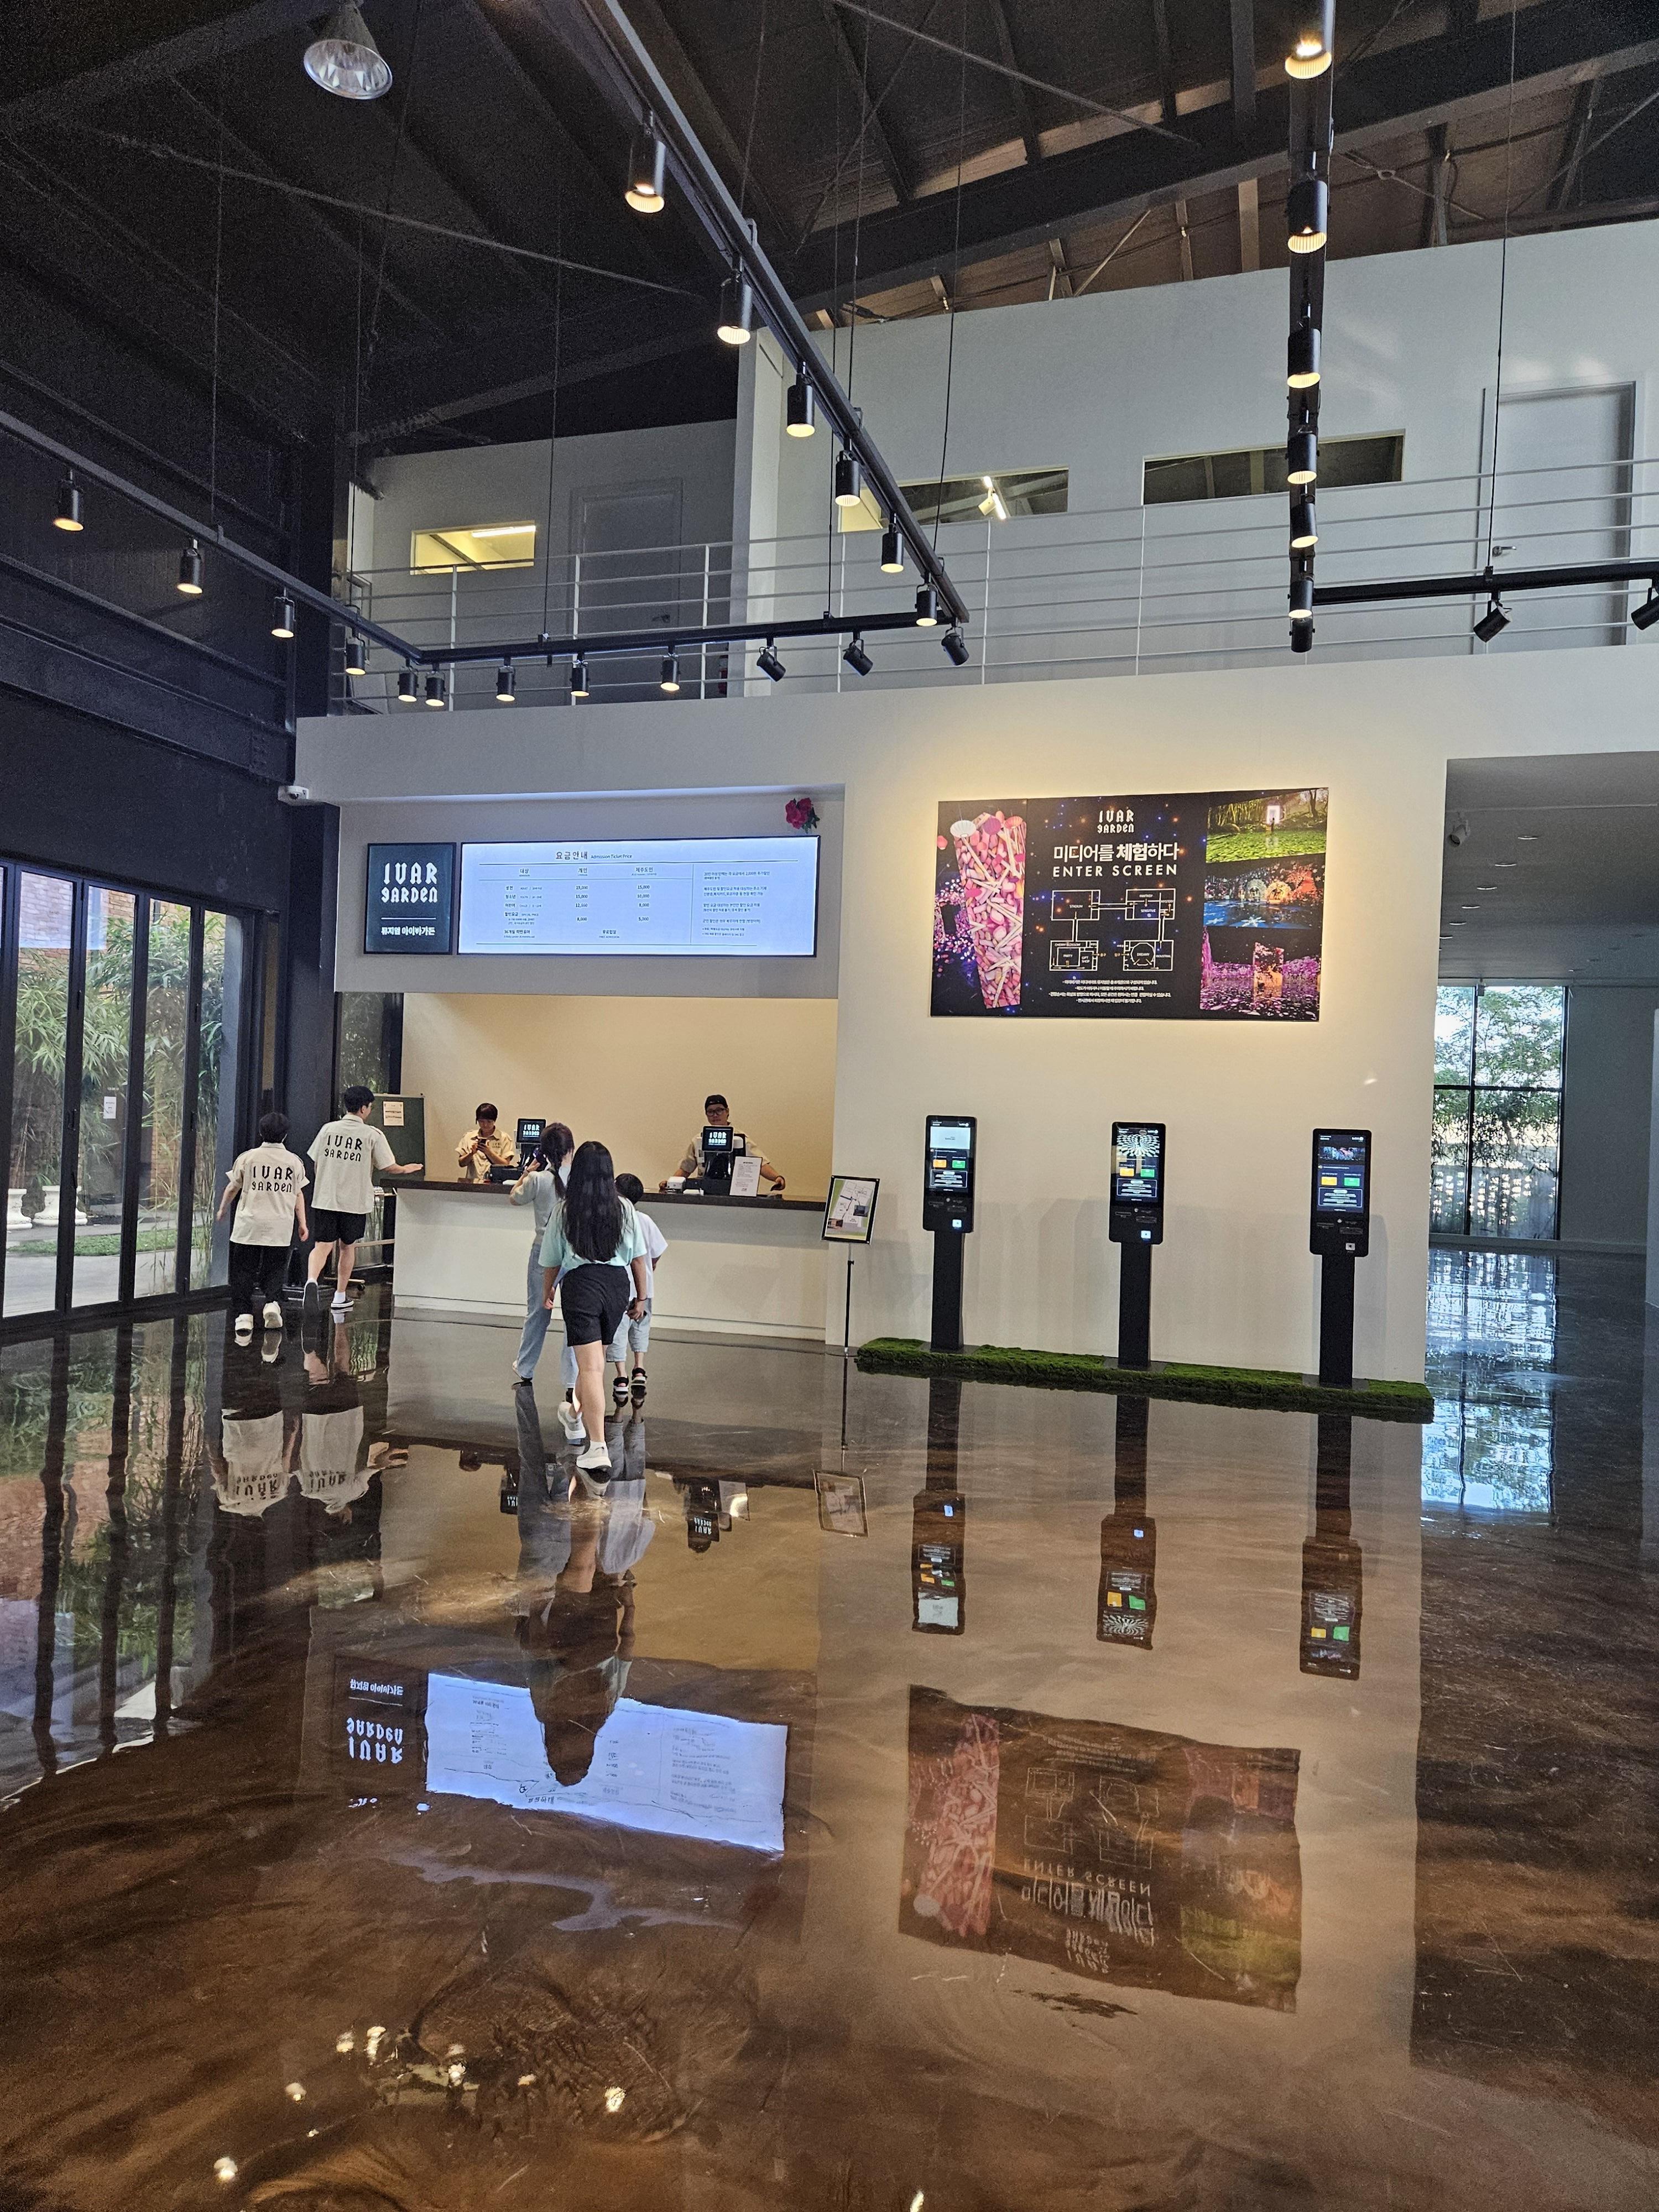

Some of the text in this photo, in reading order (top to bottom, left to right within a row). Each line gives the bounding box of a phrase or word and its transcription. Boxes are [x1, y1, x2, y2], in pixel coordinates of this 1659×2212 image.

[556, 851, 588, 860] 요금안내
[1054, 842, 1180, 863] 미디어를 체험하다
[1053, 864, 1177, 877] ENTER SCREEN
[381, 926, 435, 936] 뮤지엄 아이바가든
